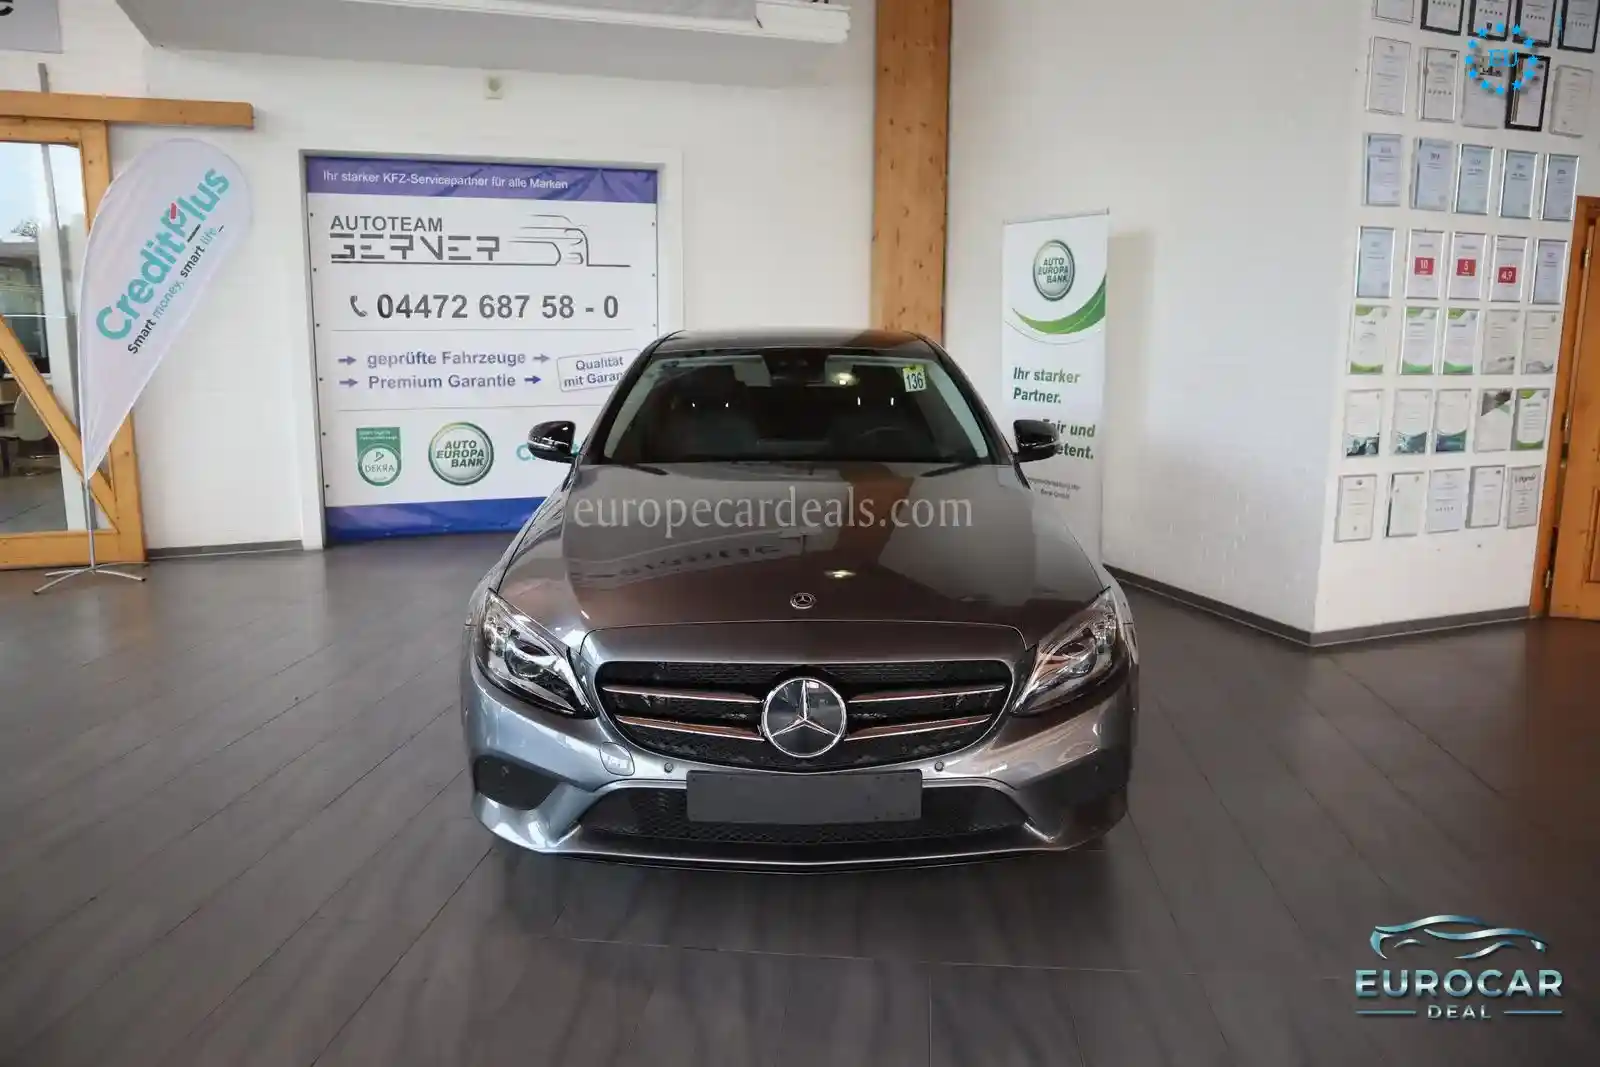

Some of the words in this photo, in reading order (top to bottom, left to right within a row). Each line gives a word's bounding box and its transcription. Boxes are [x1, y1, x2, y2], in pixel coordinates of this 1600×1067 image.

[323, 170, 338, 181] Ihr
[341, 171, 380, 184] starker
[383, 172, 488, 188] KFZ-Servicepartner
[492, 176, 505, 188] für
[508, 177, 527, 189] alle
[529, 178, 569, 190] Marken
[330, 215, 443, 233] AUTOTEAM
[96, 168, 230, 340] CreditPlus
[1043, 257, 1065, 266] AUTO
[1038, 265, 1069, 276] EUROPA
[1046, 274, 1069, 284] BANK
[127, 318, 156, 354] Smart
[180, 245, 206, 278] smart
[377, 294, 468, 319] 04472
[479, 295, 531, 319] 687
[541, 295, 575, 319] 58
[603, 295, 620, 319] 0
[367, 351, 437, 369] geprüfte
[442, 350, 526, 367] Fahrzeuge
[576, 356, 624, 372] Qualität
[368, 375, 443, 389] Premium
[448, 374, 517, 388] Garantie
[564, 375, 584, 388] mit
[906, 371, 924, 390] 136
[1013, 367, 1031, 380] Ihr
[1033, 368, 1081, 384] starker
[1013, 387, 1062, 404] Partner.
[1069, 423, 1096, 438] und
[444, 439, 477, 450] AUTO
[436, 448, 485, 459] EUROPA
[364, 463, 395, 473] DEKRA
[450, 457, 485, 468] BANK
